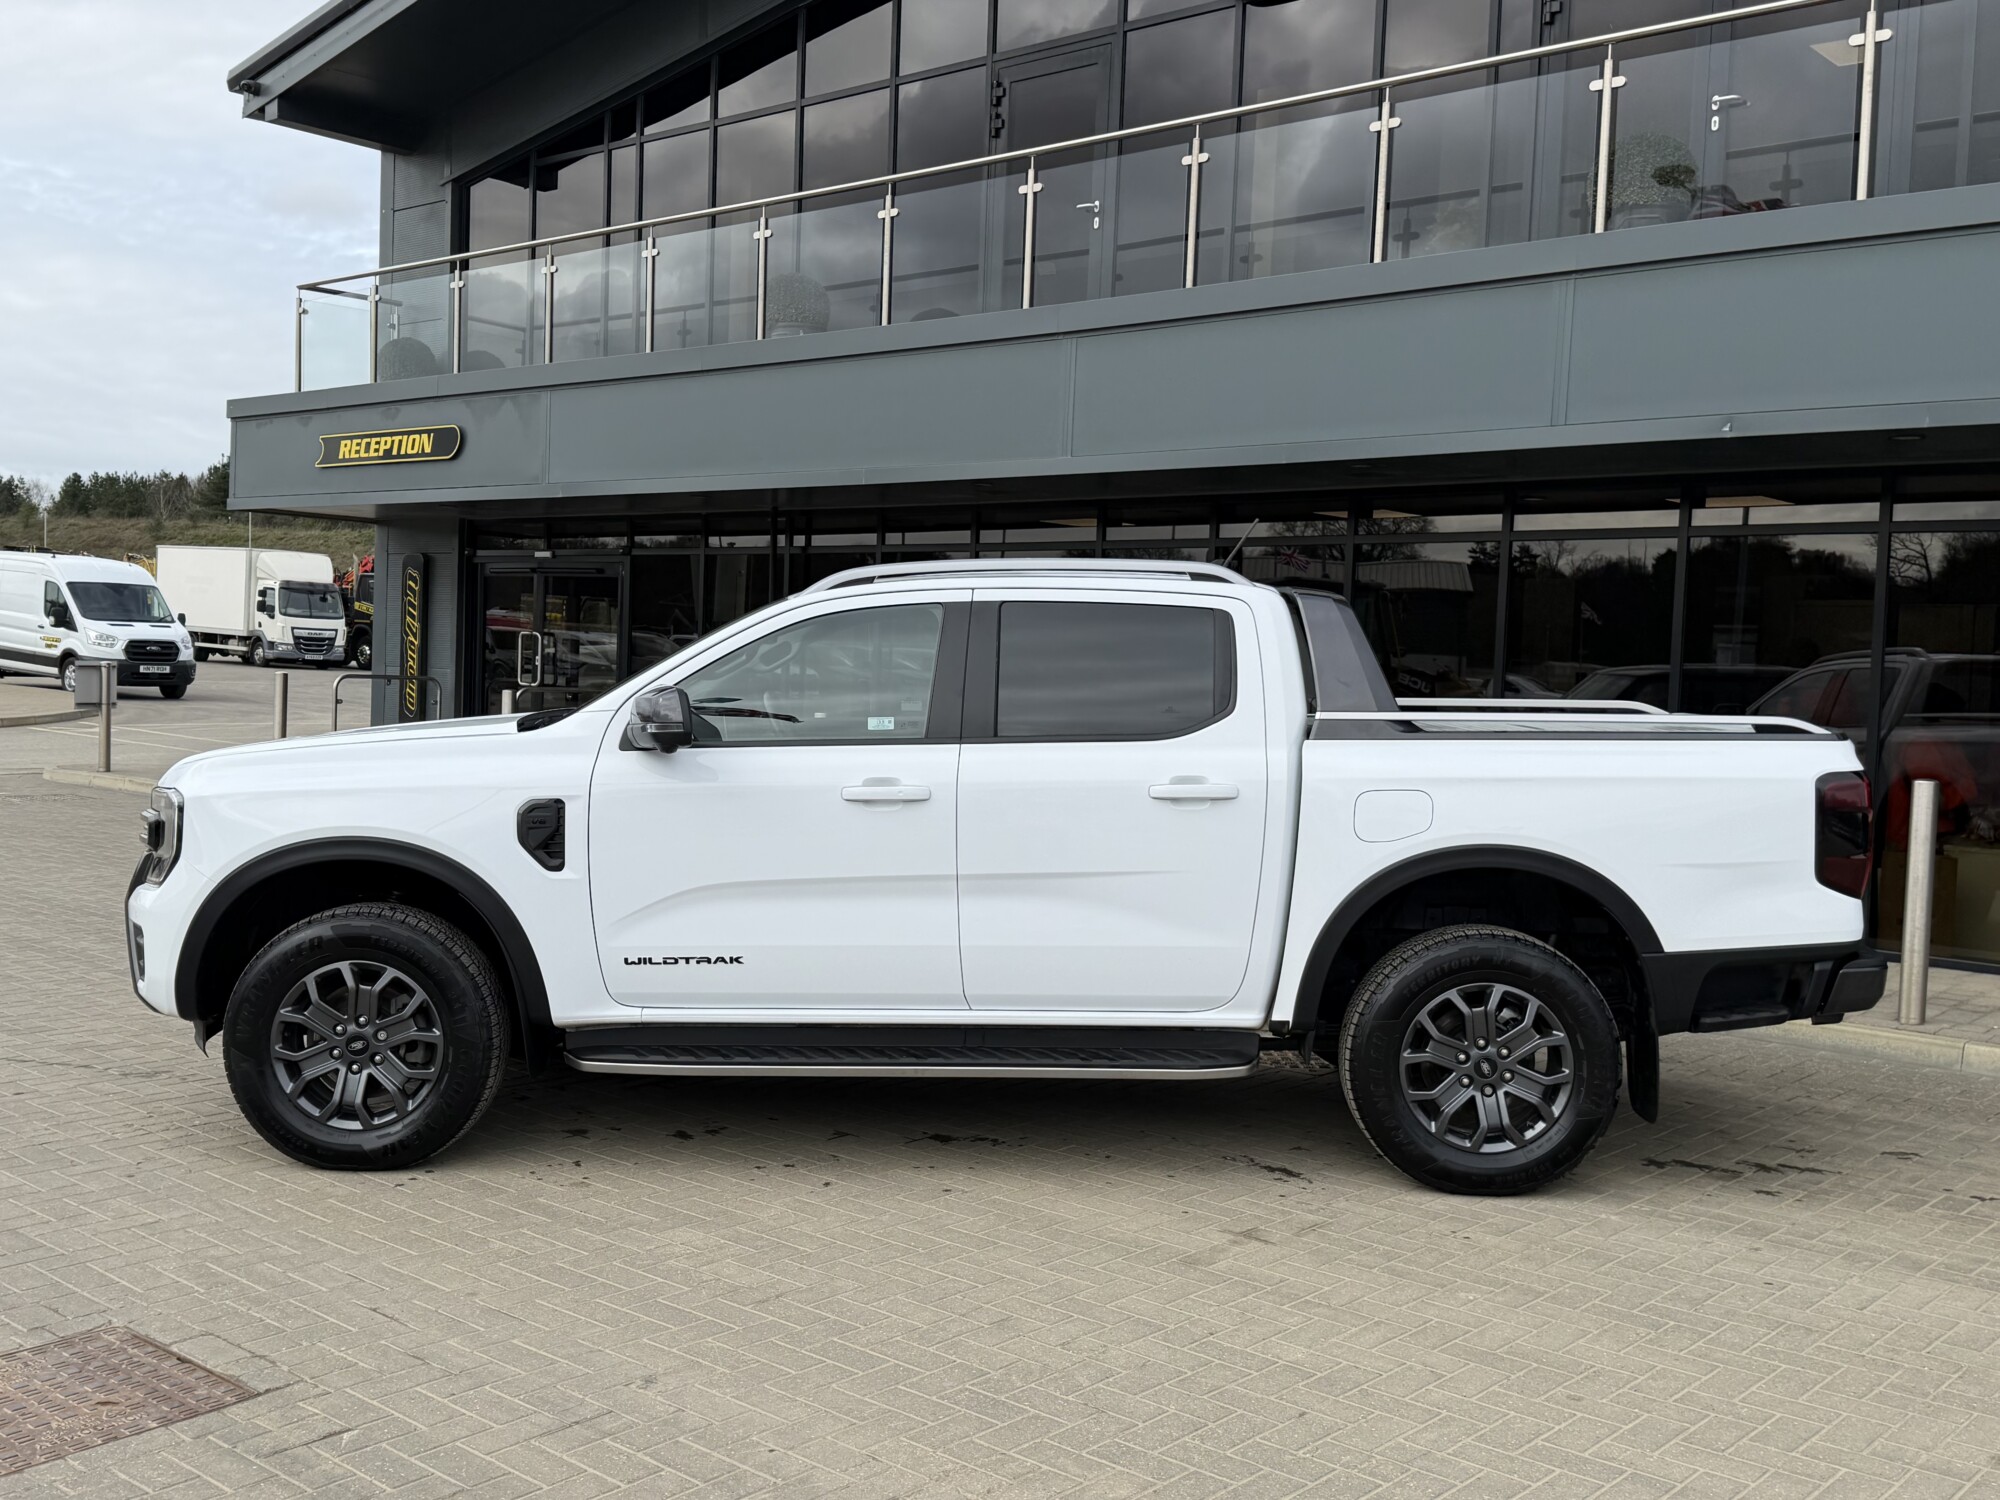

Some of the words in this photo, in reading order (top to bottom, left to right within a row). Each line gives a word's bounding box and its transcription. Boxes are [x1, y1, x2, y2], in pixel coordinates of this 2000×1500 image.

[338, 432, 434, 460] RECEPTION
[531, 817, 546, 825] V6
[623, 956, 744, 965] WILDTRAK
[1403, 955, 1480, 998] TERRITORY
